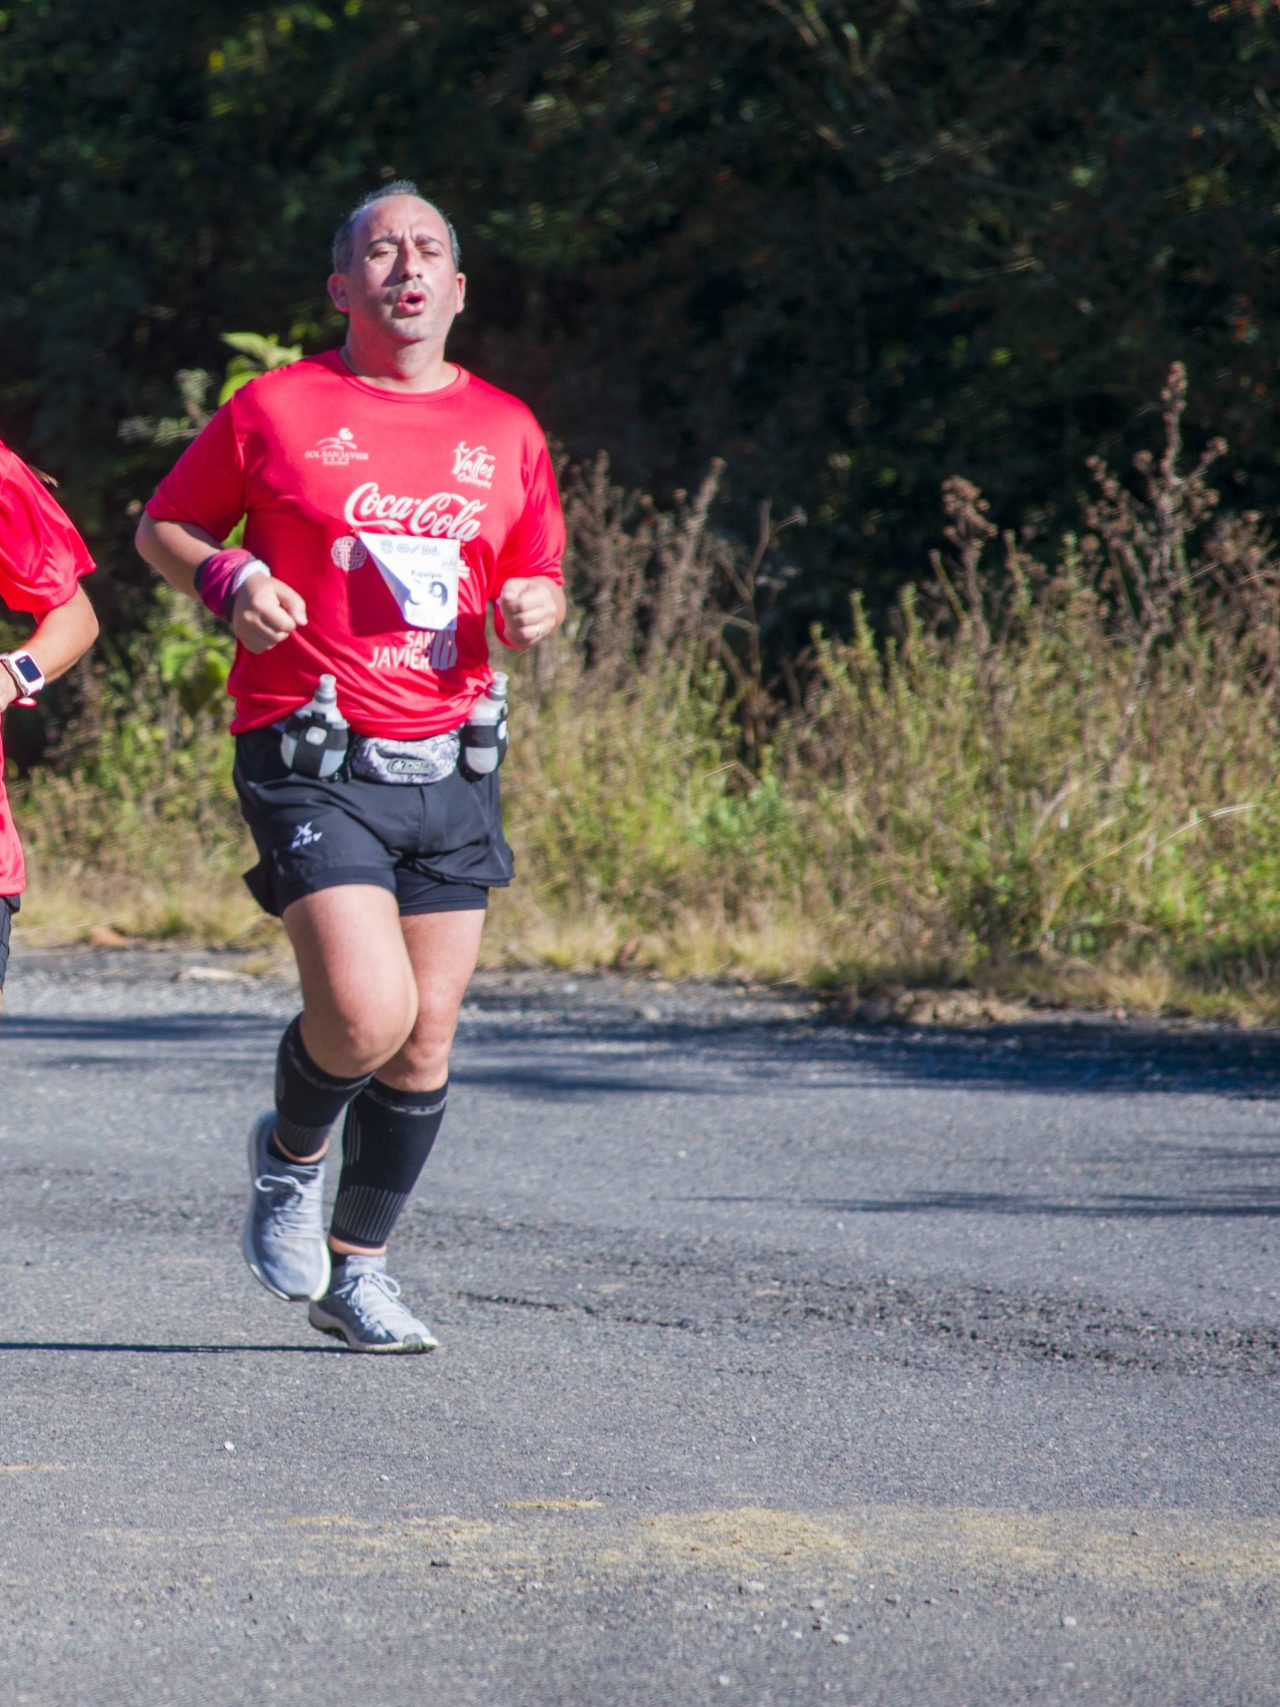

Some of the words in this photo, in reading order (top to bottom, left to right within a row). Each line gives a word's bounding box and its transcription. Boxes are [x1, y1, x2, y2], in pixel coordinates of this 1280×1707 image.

[344, 482, 487, 541] Coca-Cola
[406, 631, 436, 648] SAN
[367, 646, 432, 671] JAVIER
